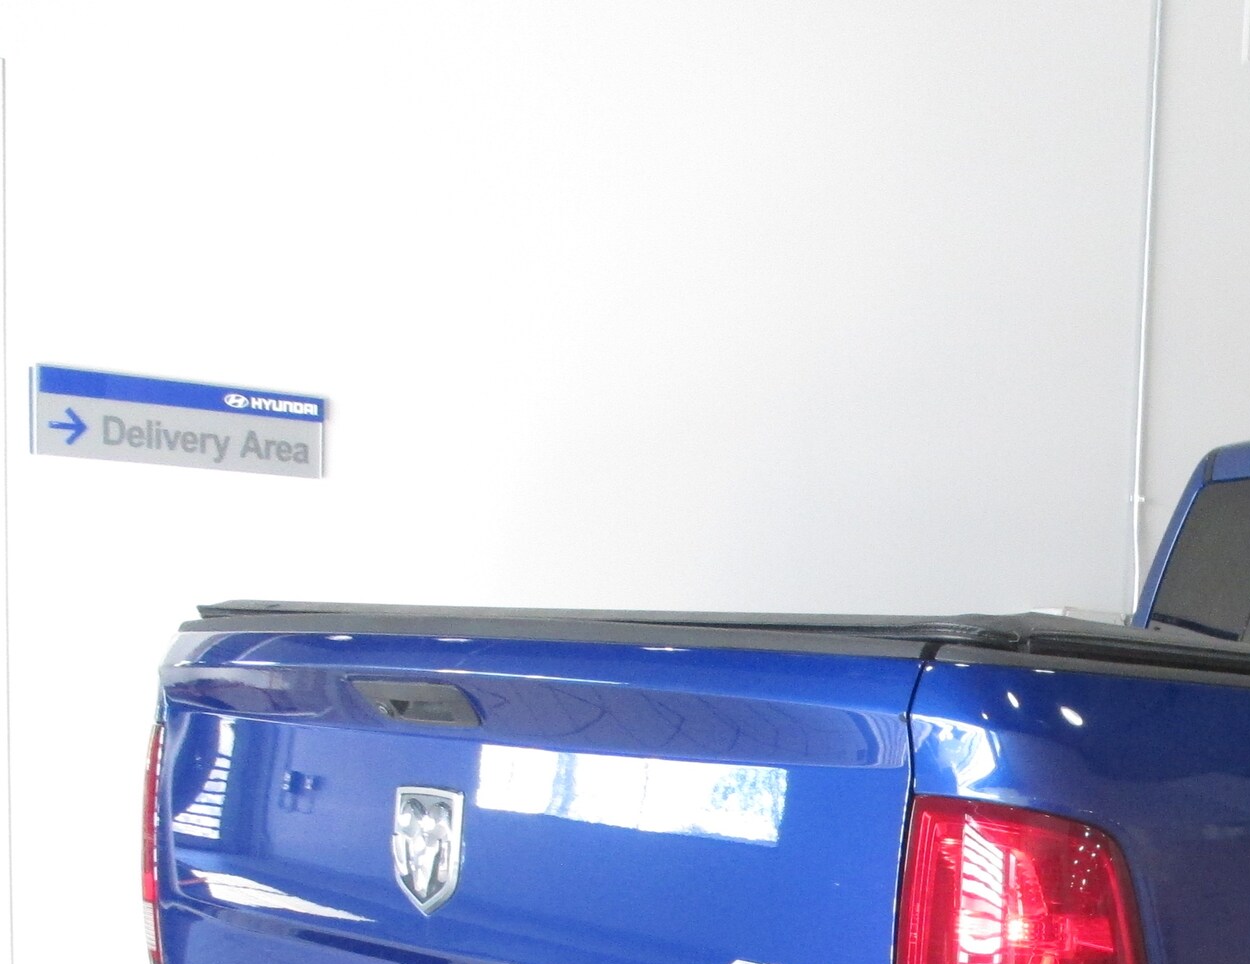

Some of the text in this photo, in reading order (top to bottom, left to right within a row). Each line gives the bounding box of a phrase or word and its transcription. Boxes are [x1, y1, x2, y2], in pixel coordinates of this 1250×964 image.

[251, 397, 318, 416] HYUNDAI
[102, 414, 310, 464] Delivery Area
